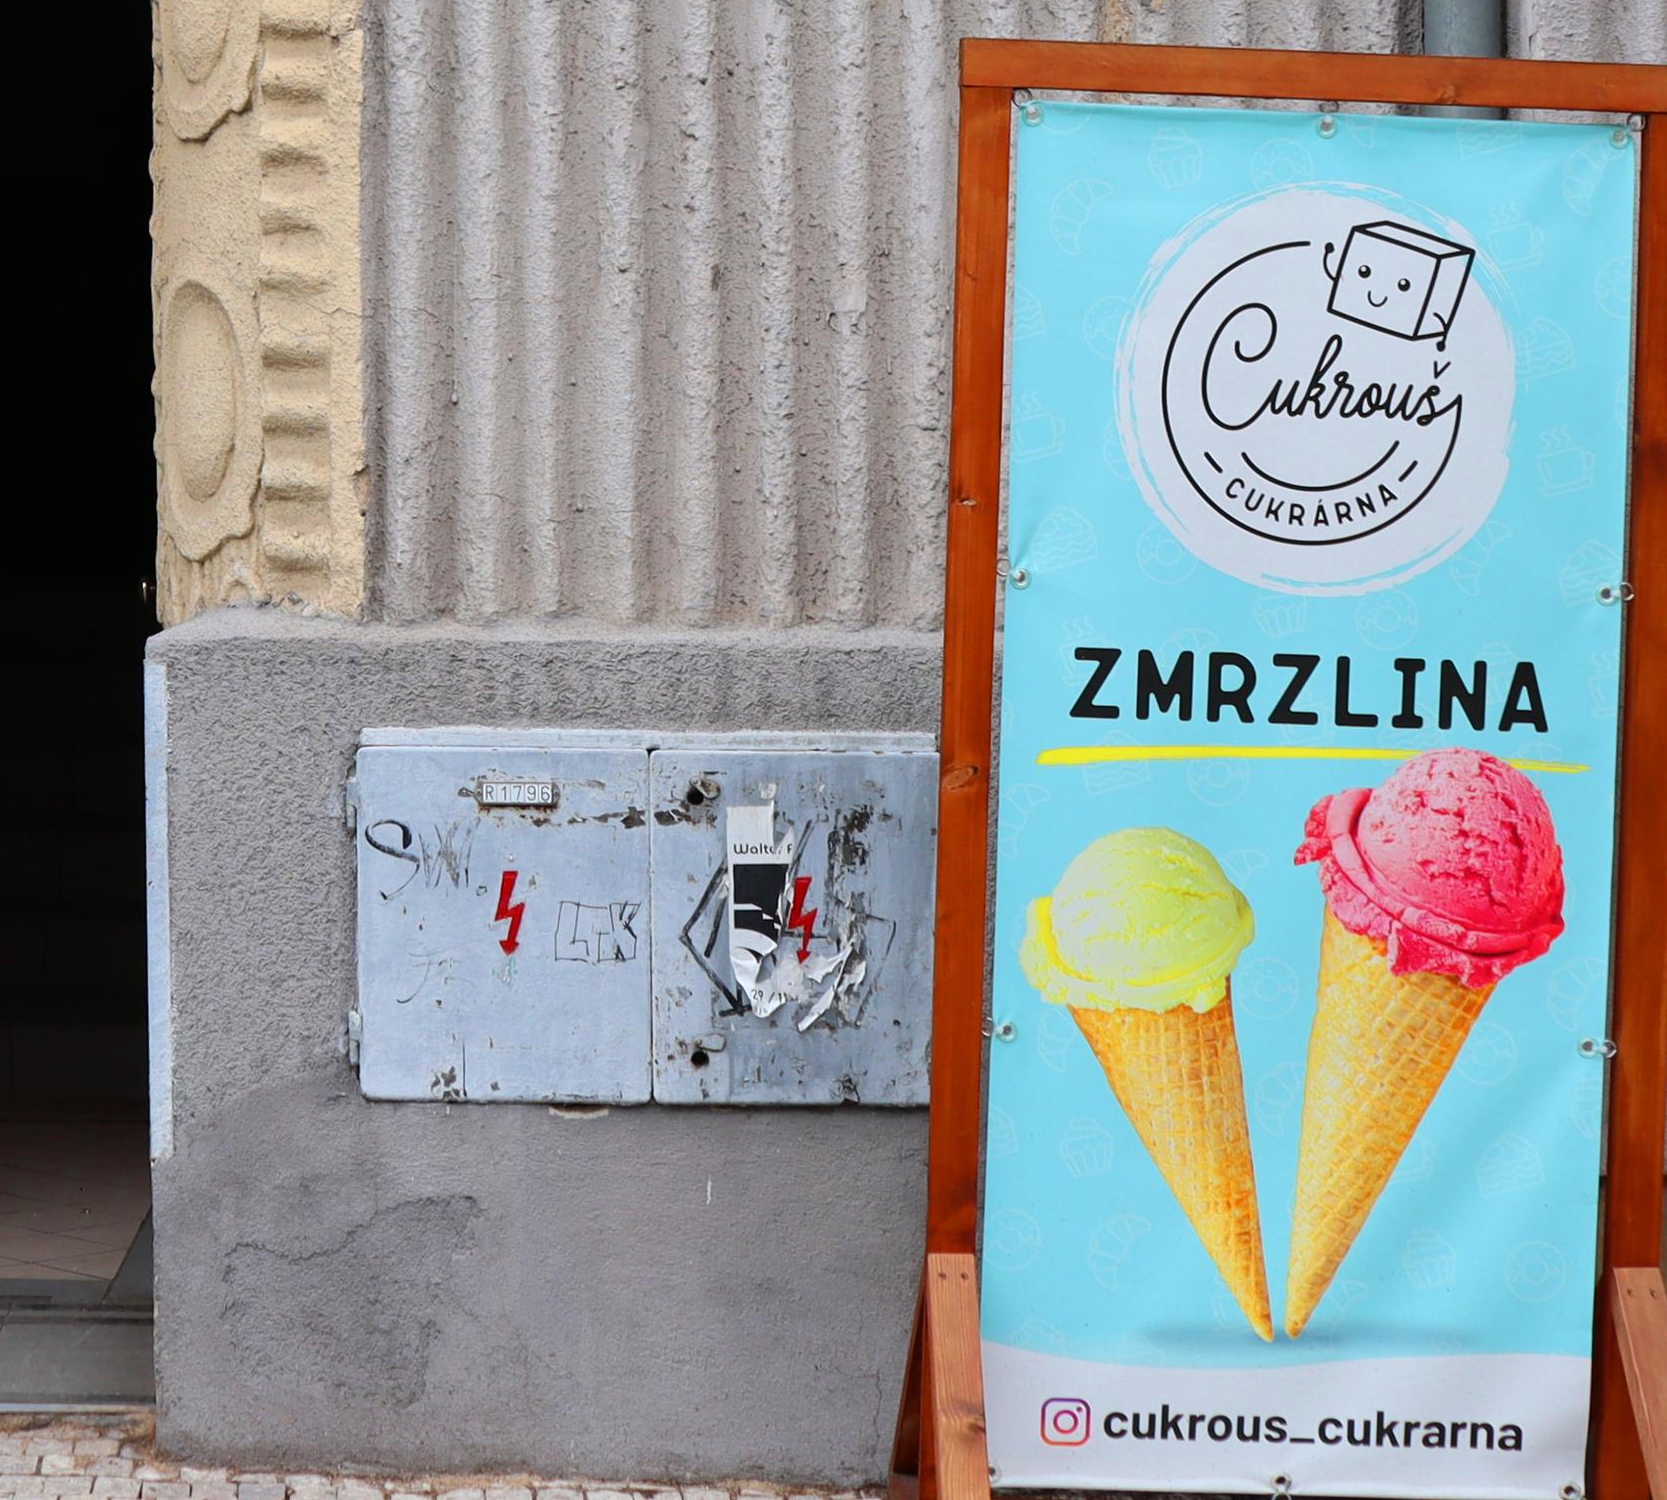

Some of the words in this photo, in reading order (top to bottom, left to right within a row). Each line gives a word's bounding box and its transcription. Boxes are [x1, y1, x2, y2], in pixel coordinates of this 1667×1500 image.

[1201, 302, 1457, 431] Cukrouš
[1225, 477, 1399, 527] CUKRÁRNA
[1069, 647, 1549, 733] ZMRZLINA
[1103, 1404, 1524, 1452] cukrous_cukrarna
